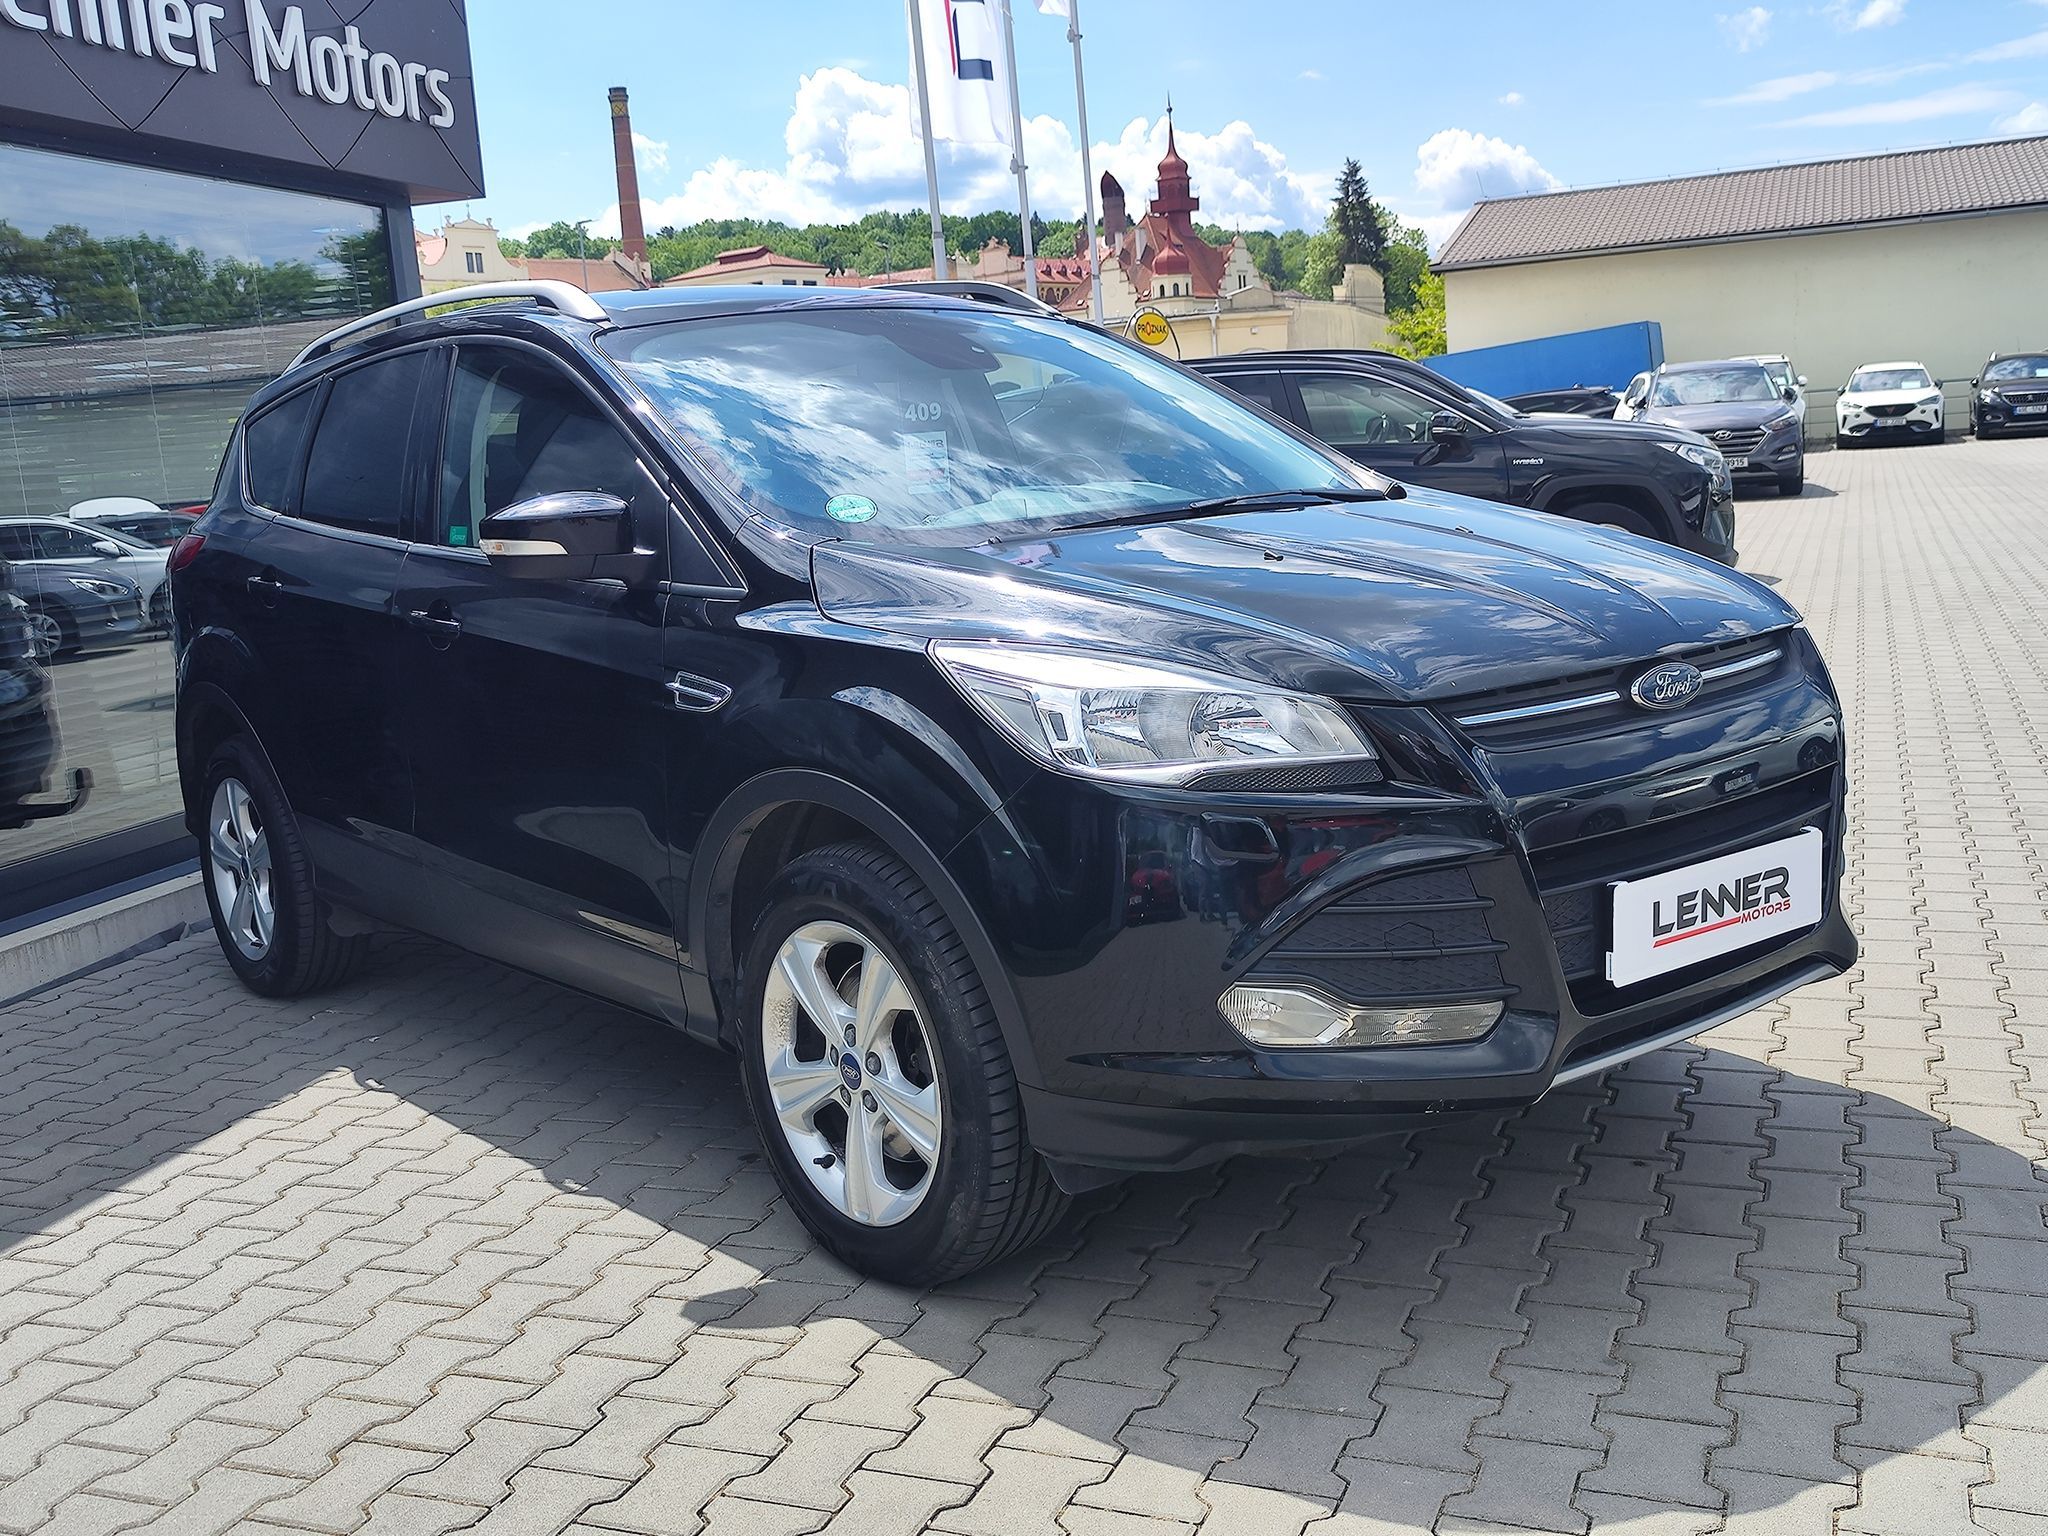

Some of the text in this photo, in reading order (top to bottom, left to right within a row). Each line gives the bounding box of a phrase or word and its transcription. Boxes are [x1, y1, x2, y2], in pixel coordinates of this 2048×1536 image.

[243, 0, 456, 129] Motors
[1137, 322, 1167, 336] PROZNAK
[905, 402, 942, 421] 409
[1655, 669, 1693, 700] Ford
[1653, 866, 1791, 937] LENNER
[1741, 899, 1791, 924] MOTORS
